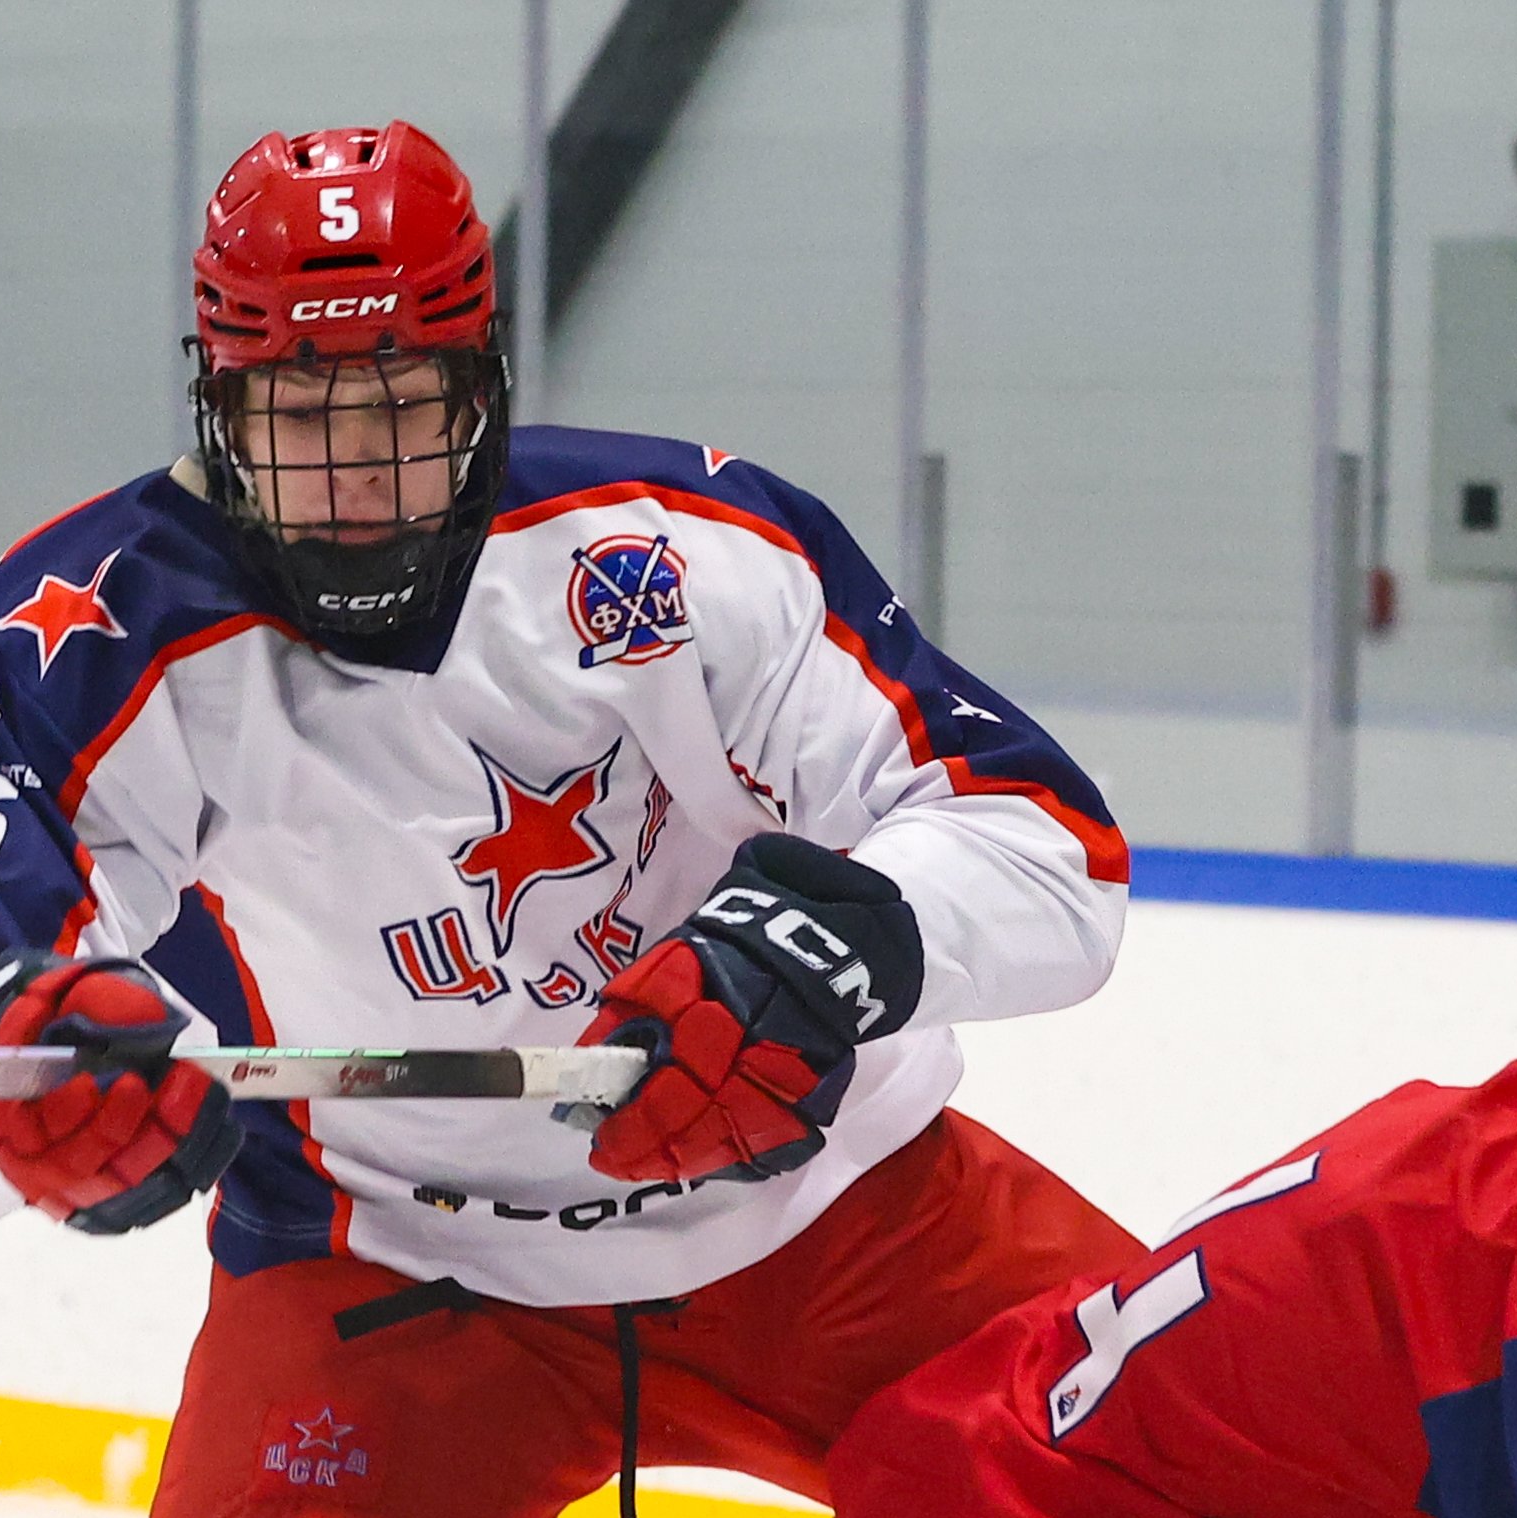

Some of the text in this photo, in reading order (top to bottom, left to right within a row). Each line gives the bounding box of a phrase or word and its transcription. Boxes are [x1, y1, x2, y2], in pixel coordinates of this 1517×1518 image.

[318, 186, 361, 242] 5
[290, 292, 399, 323] CCM
[589, 585, 686, 636] ФХМ
[697, 887, 887, 1037] CCM
